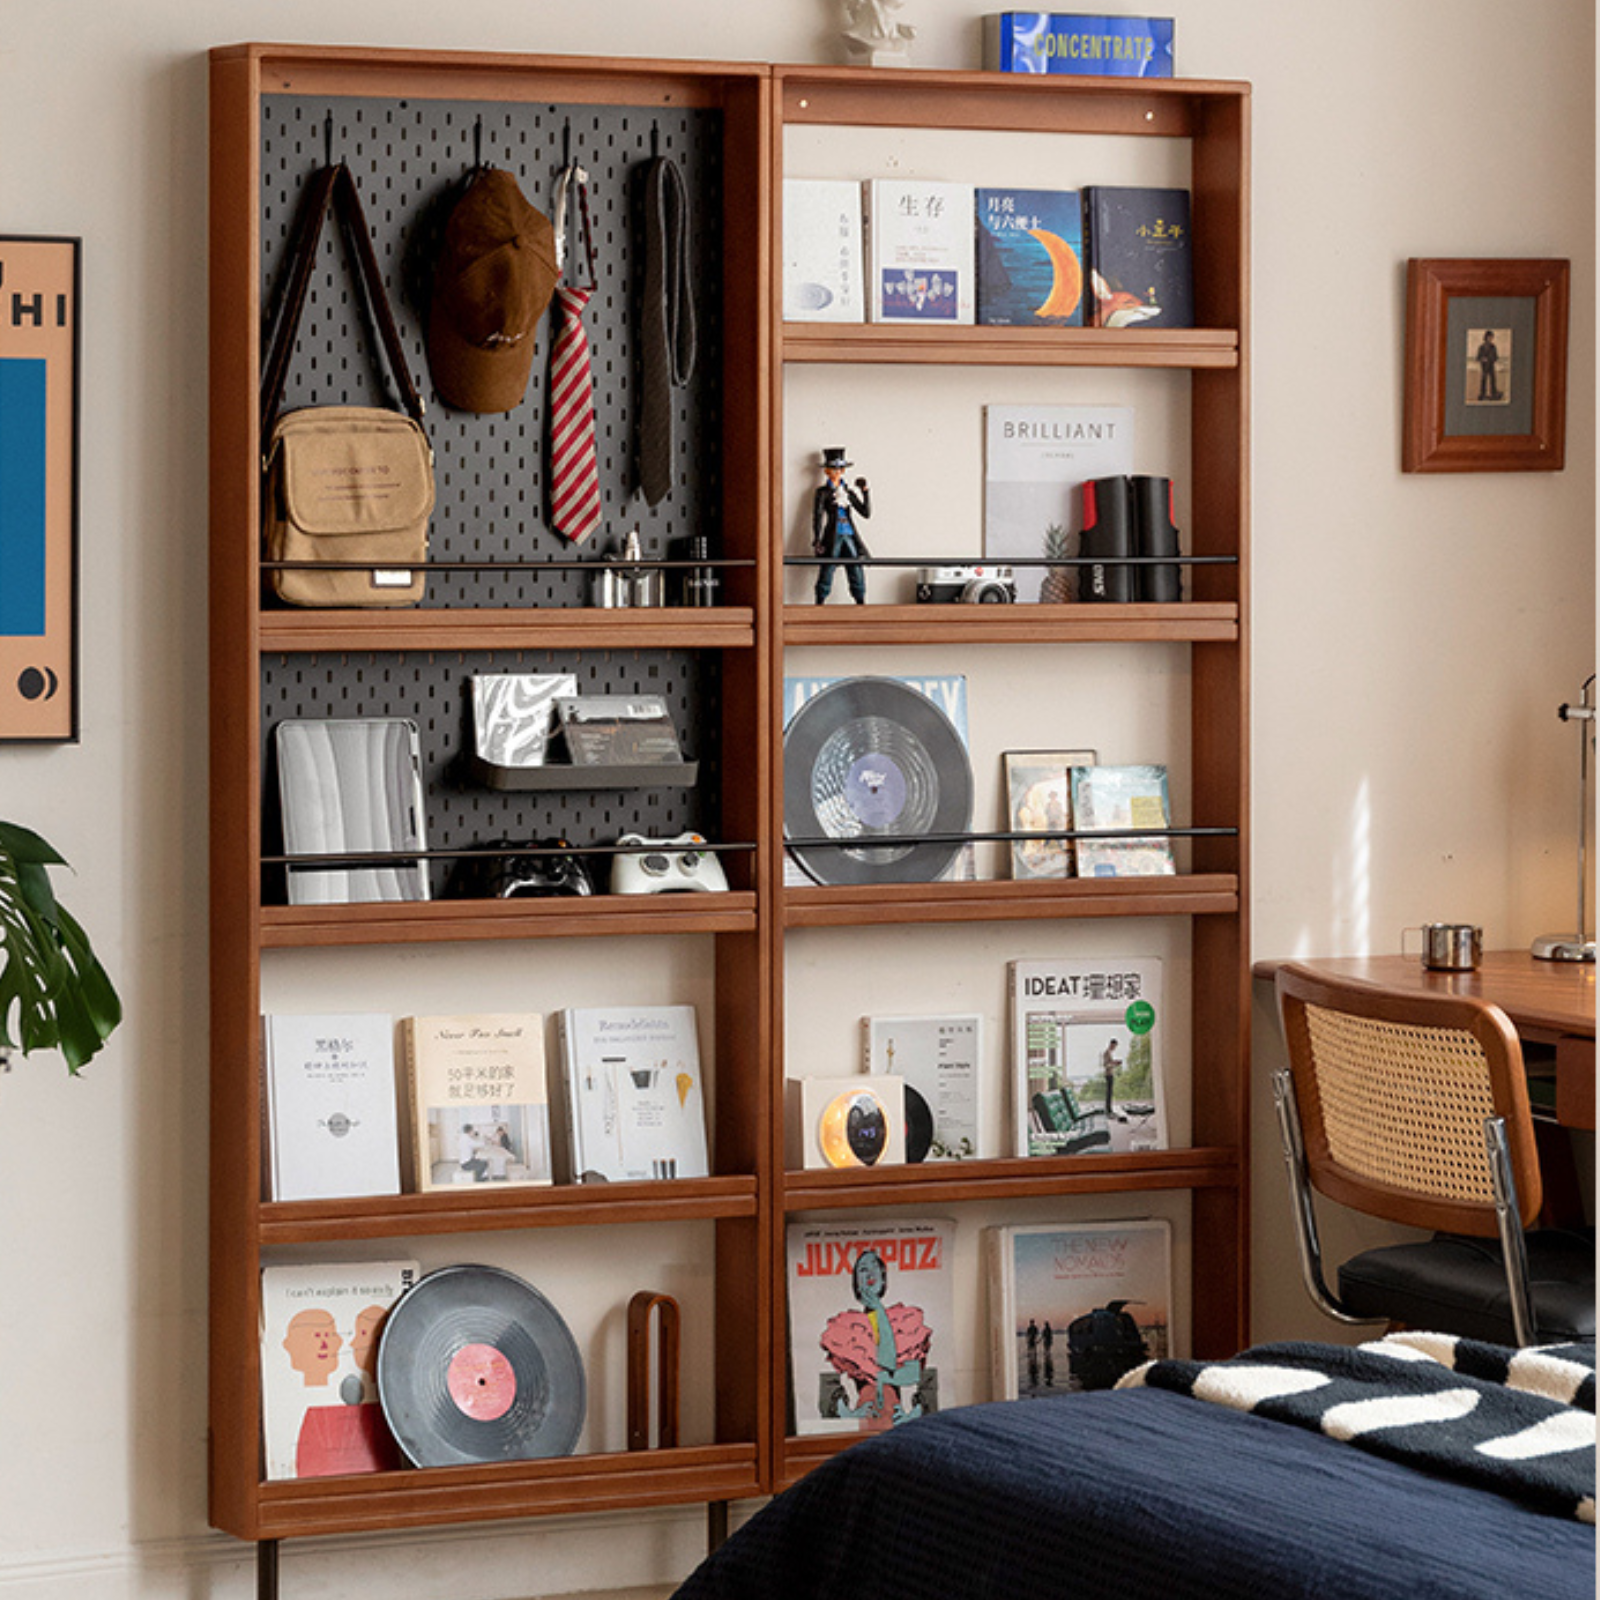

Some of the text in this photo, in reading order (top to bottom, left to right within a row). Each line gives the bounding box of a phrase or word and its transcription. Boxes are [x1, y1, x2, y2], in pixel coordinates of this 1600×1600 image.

[1034, 33, 1153, 61] CONCENTRATE
[898, 194, 945, 218] 生存
[1003, 420, 1116, 439] BRILLIANT
[1025, 975, 1081, 996] IDEAT
[796, 1236, 937, 1277] JUXTPOZ
